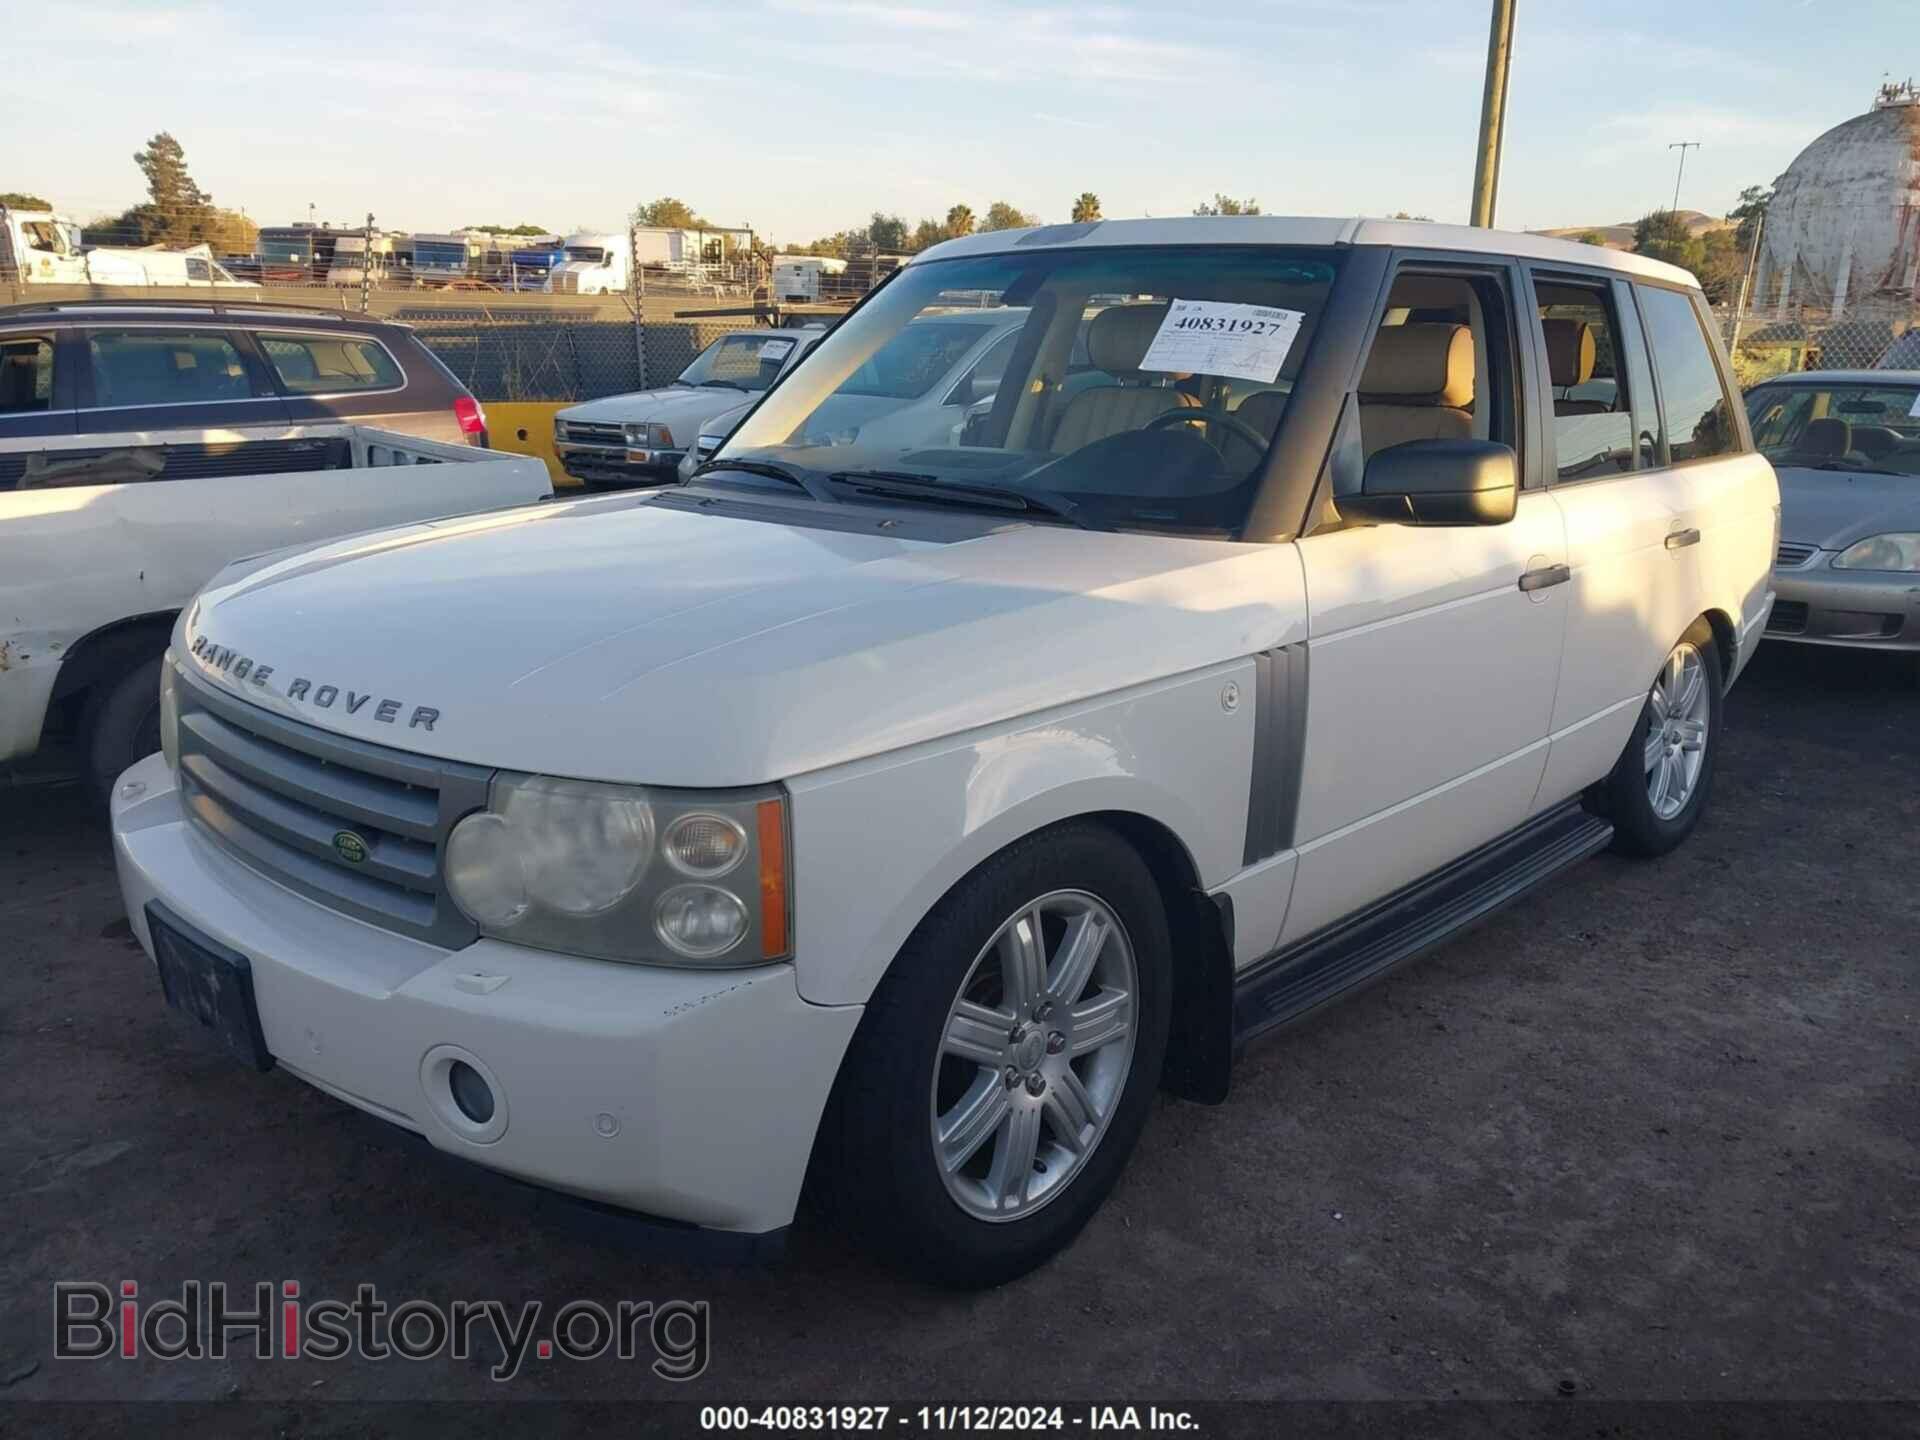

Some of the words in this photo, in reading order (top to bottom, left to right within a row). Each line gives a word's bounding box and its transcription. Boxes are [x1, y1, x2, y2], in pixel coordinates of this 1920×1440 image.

[1174, 316, 1281, 337] 40831927
[191, 634, 274, 687] RANGE
[286, 677, 440, 731] ROVER
